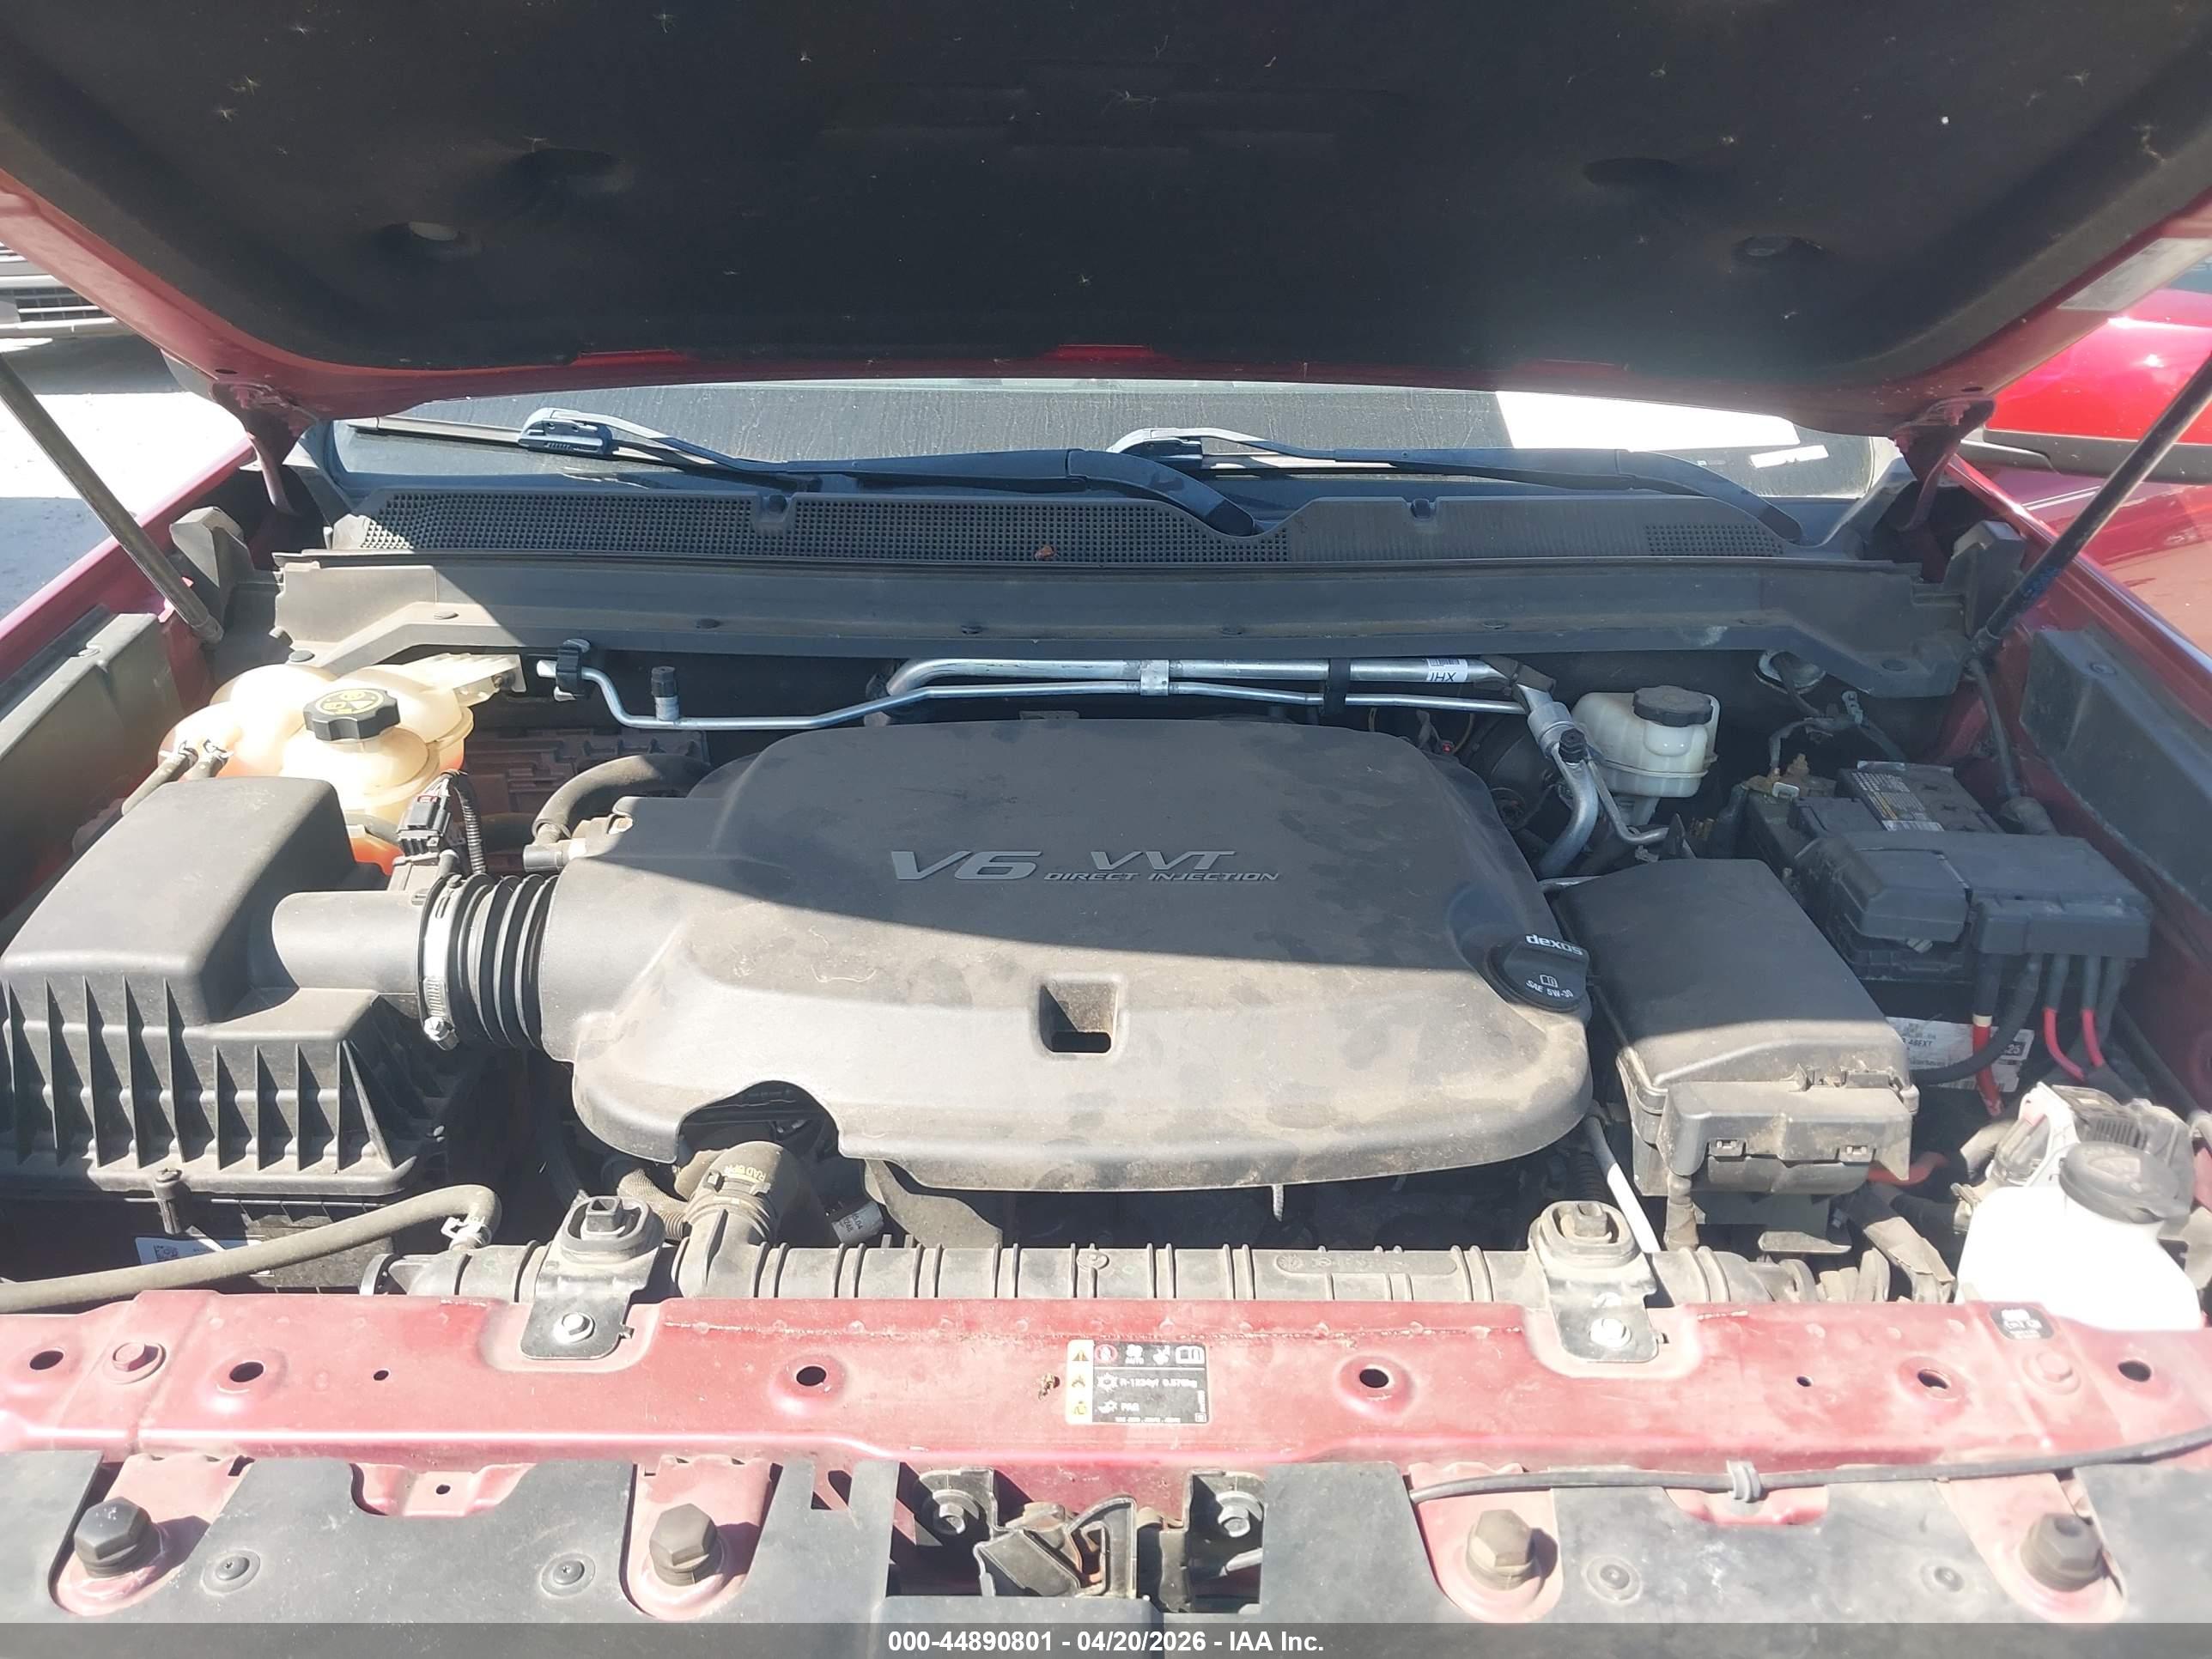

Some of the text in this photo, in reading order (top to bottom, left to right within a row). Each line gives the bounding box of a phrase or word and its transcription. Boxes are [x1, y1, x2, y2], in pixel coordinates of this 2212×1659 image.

[891, 850, 1236, 880] V6 VVT
[1043, 872, 1279, 881] DIRECT INJECTION
[1525, 934, 1583, 956] dexos
[1525, 980, 1574, 998] SAE 5W-30
